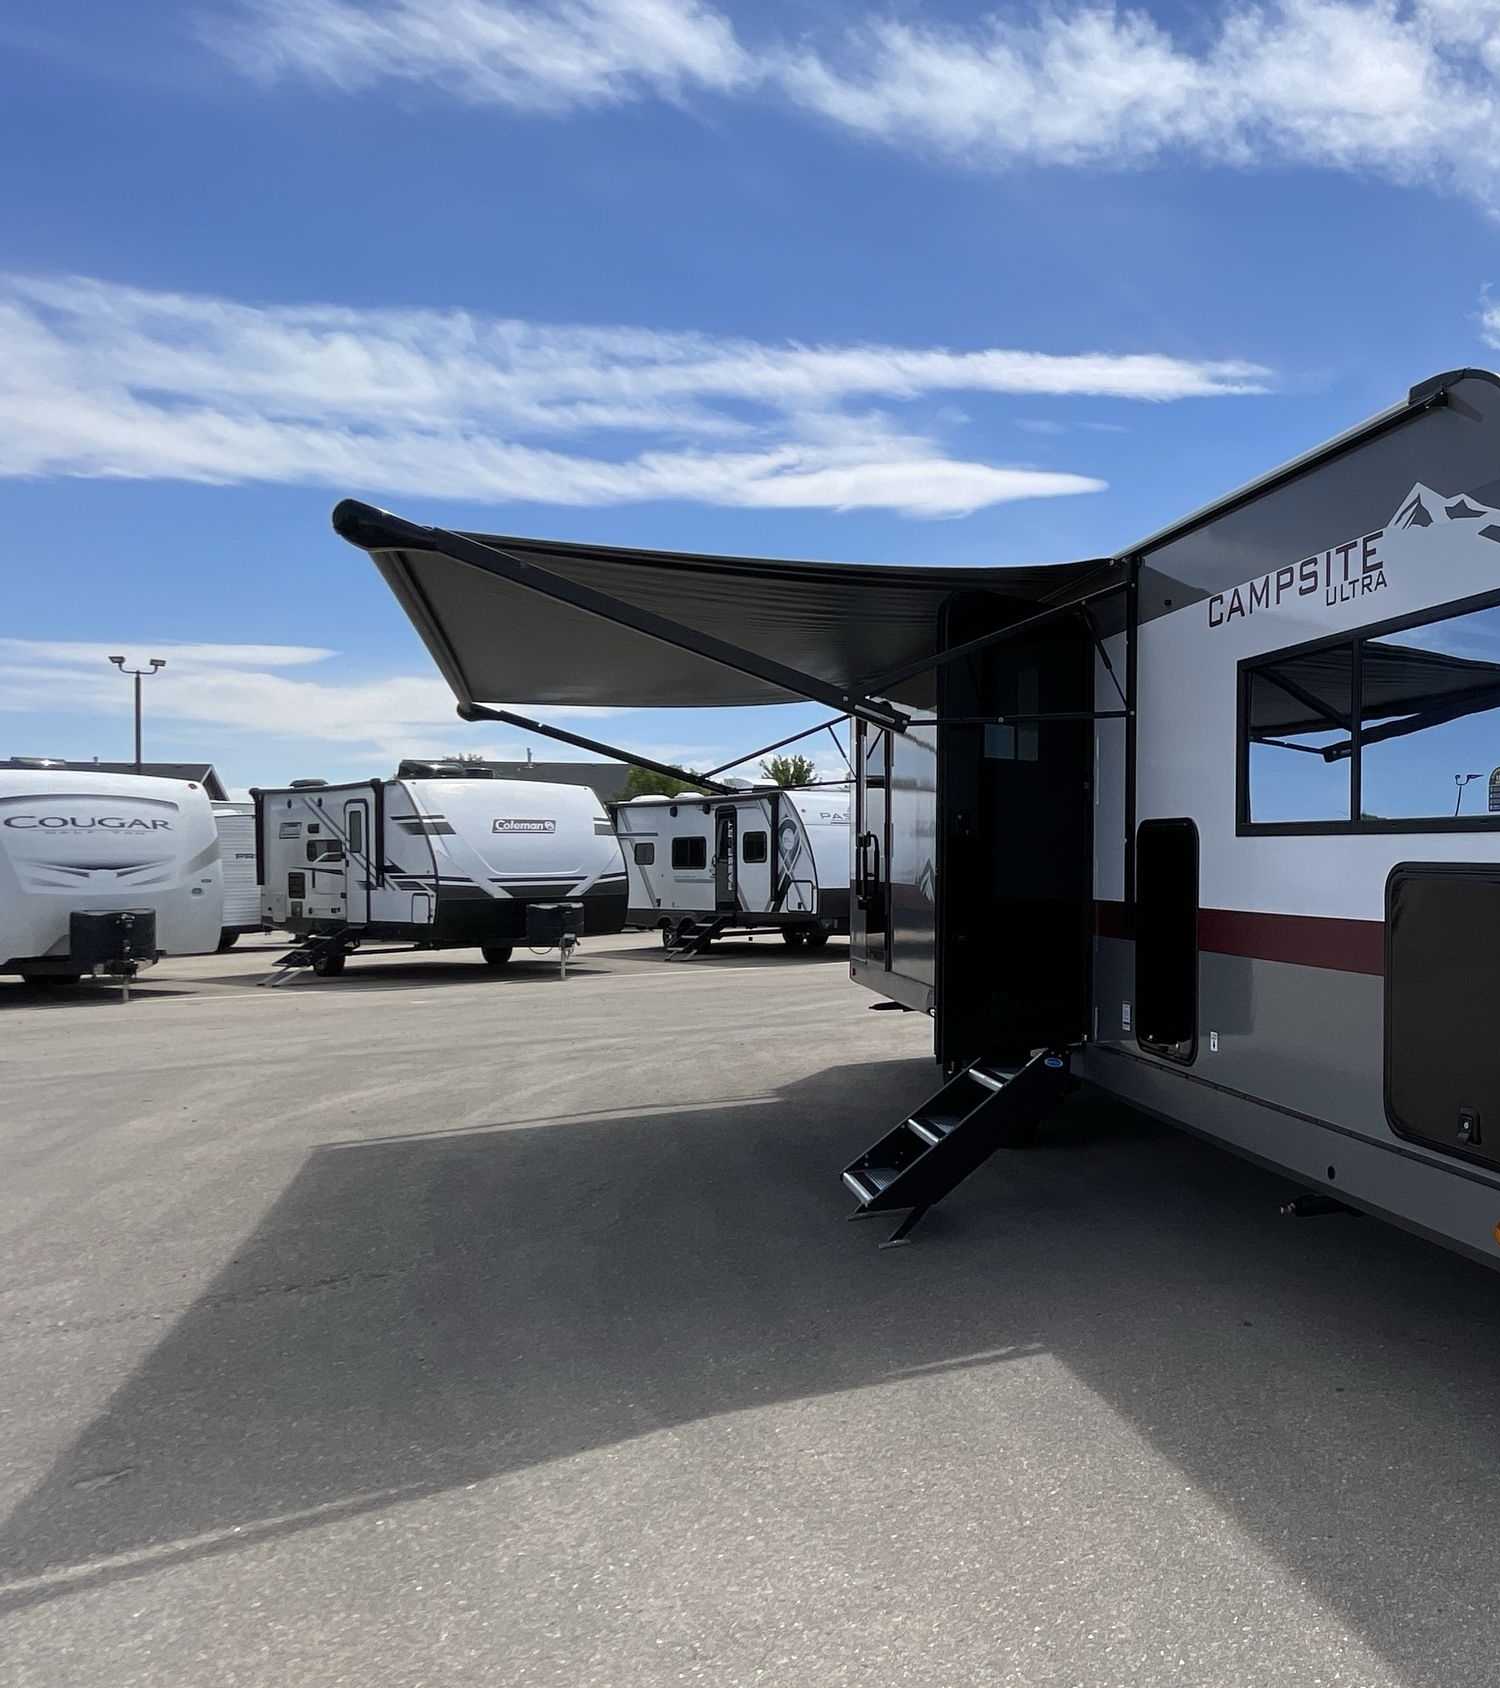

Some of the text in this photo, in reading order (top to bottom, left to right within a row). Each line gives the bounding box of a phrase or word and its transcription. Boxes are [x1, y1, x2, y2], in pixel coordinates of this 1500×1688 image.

[1209, 531, 1384, 628] CAMPSITE
[1326, 570, 1388, 606] ULTRA
[3, 815, 174, 831] COUGAR
[495, 820, 543, 830] Coleman
